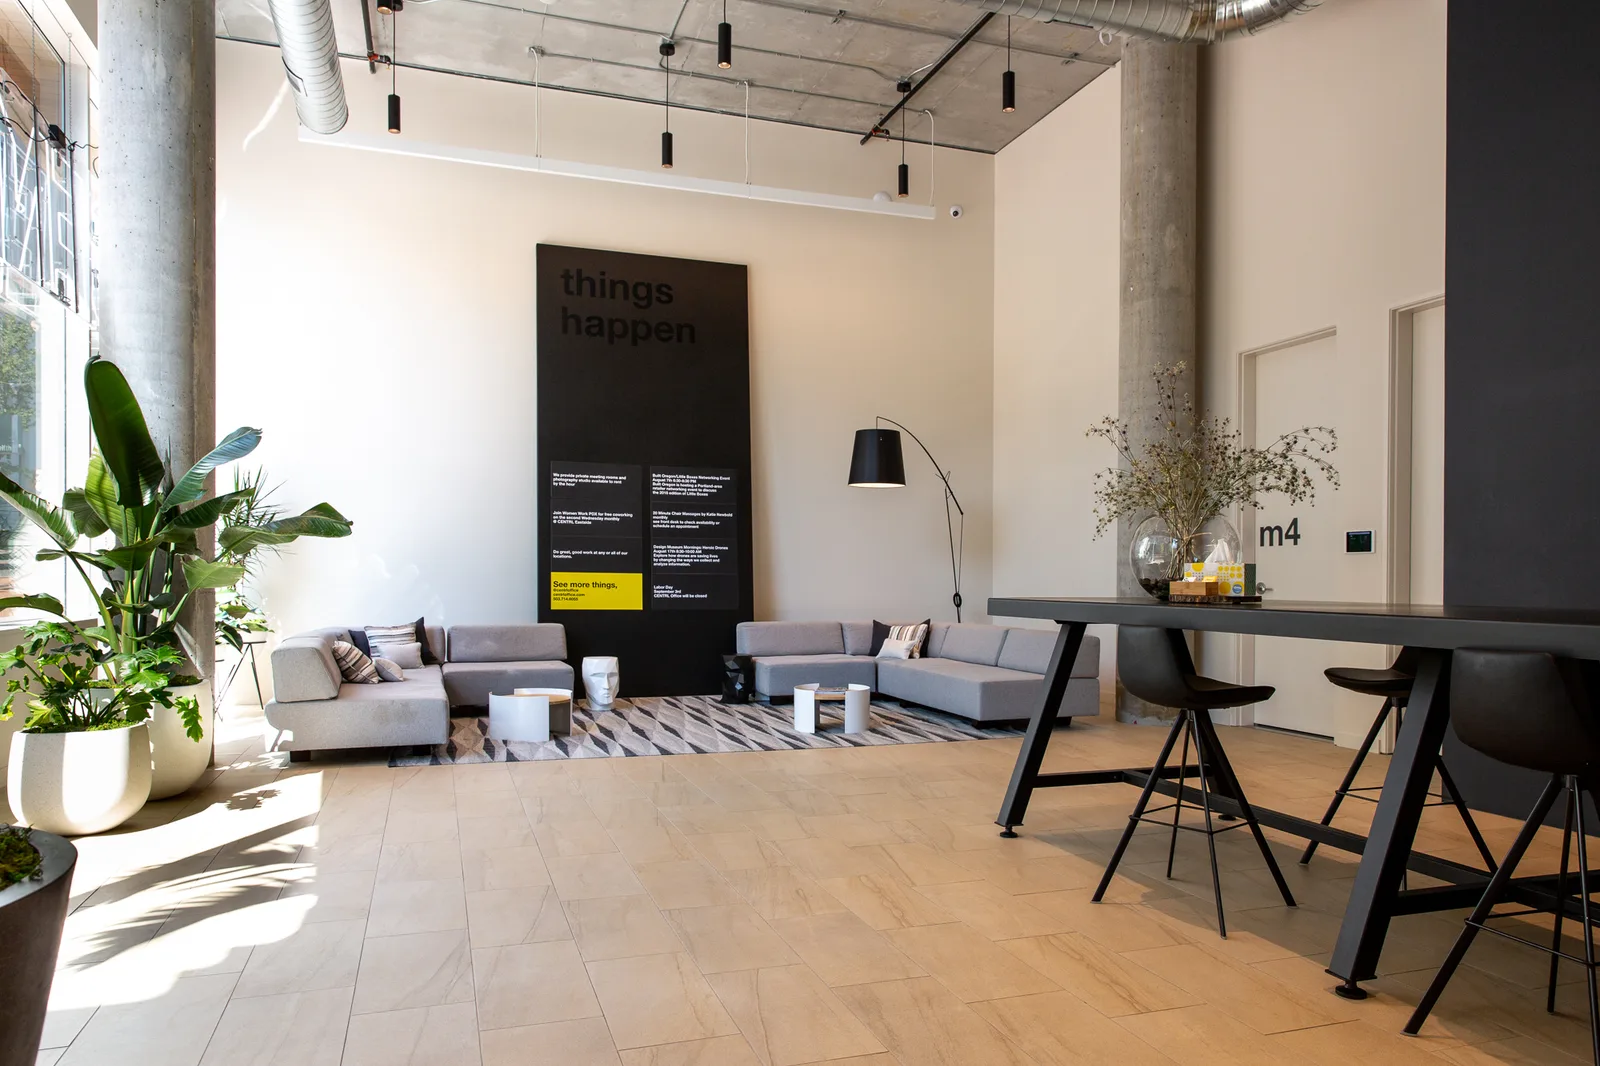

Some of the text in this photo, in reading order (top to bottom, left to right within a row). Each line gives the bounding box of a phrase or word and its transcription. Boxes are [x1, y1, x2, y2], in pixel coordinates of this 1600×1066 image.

[561, 268, 674, 309] things
[561, 306, 696, 346] happen
[1260, 517, 1301, 547] m4
